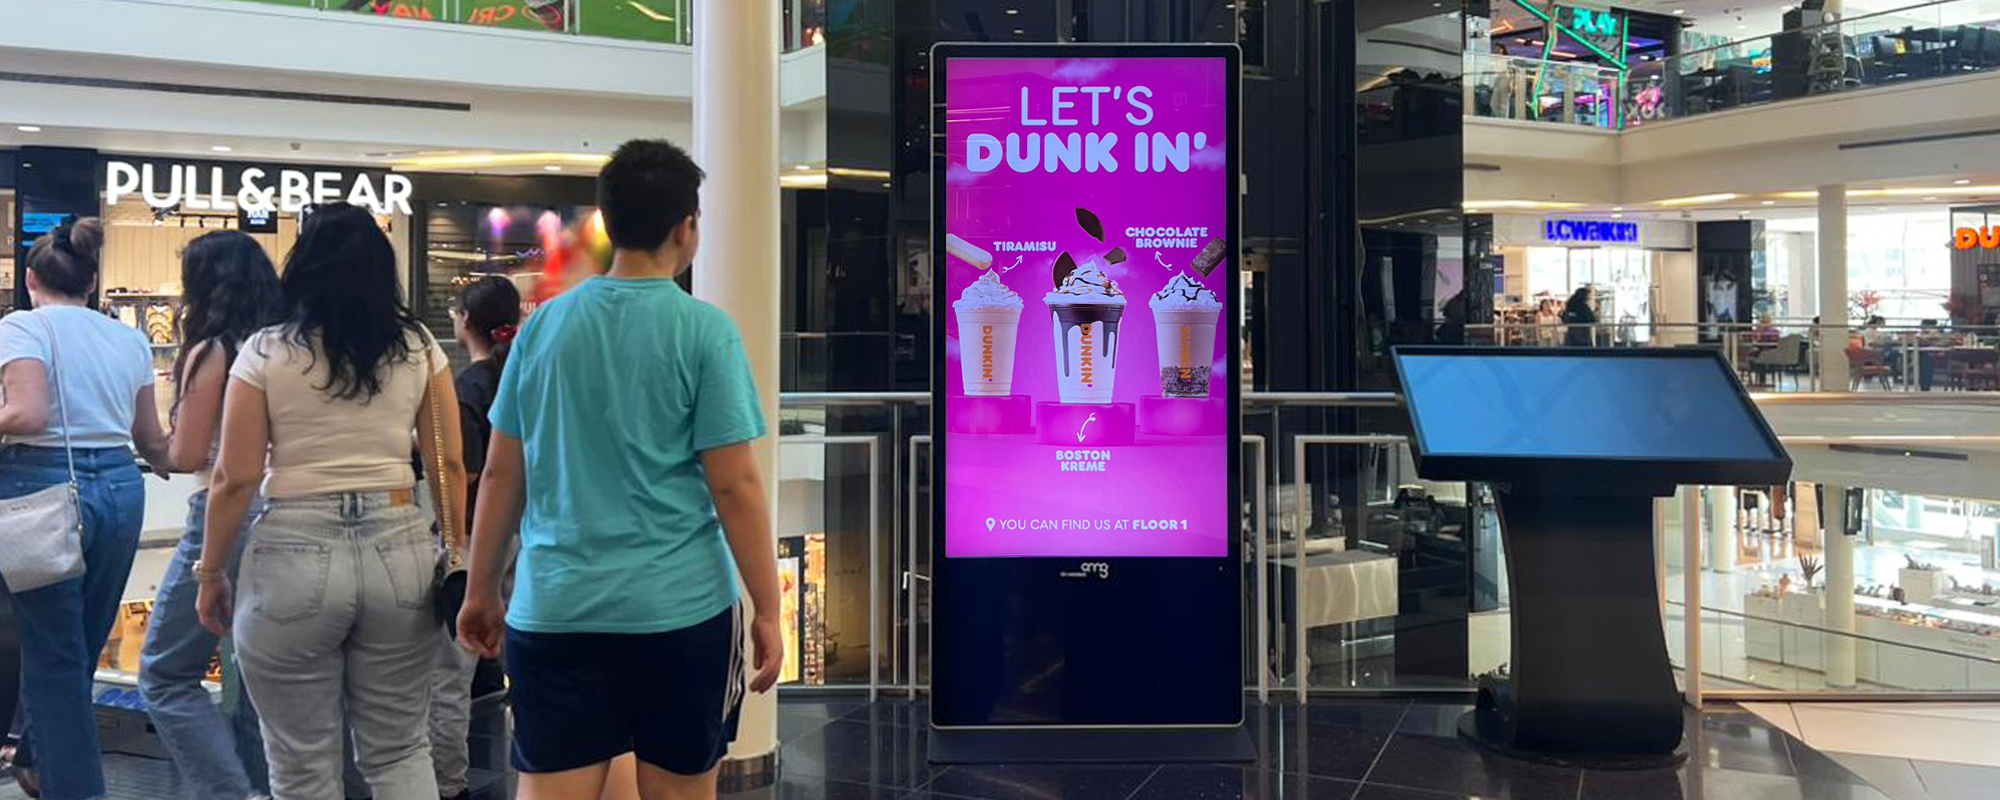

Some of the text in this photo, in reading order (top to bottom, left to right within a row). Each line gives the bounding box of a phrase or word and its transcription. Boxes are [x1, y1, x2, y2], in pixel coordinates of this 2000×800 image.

[1021, 86, 1154, 126] LET'S
[966, 131, 1207, 173] DUNK IN'
[106, 161, 413, 215] PULL&BEAR
[1125, 227, 1208, 239] CHOCOLATE
[993, 241, 1056, 252] TIRAMISU
[1135, 238, 1198, 249] BROWNIE
[982, 325, 994, 382] DUNKIN'
[1080, 323, 1093, 388] DUNKIN'
[1056, 450, 1111, 461] BOSTON
[1060, 461, 1106, 472] KREME
[1000, 519, 1188, 530] YOU CAN FIND US AT FLOOR 1
